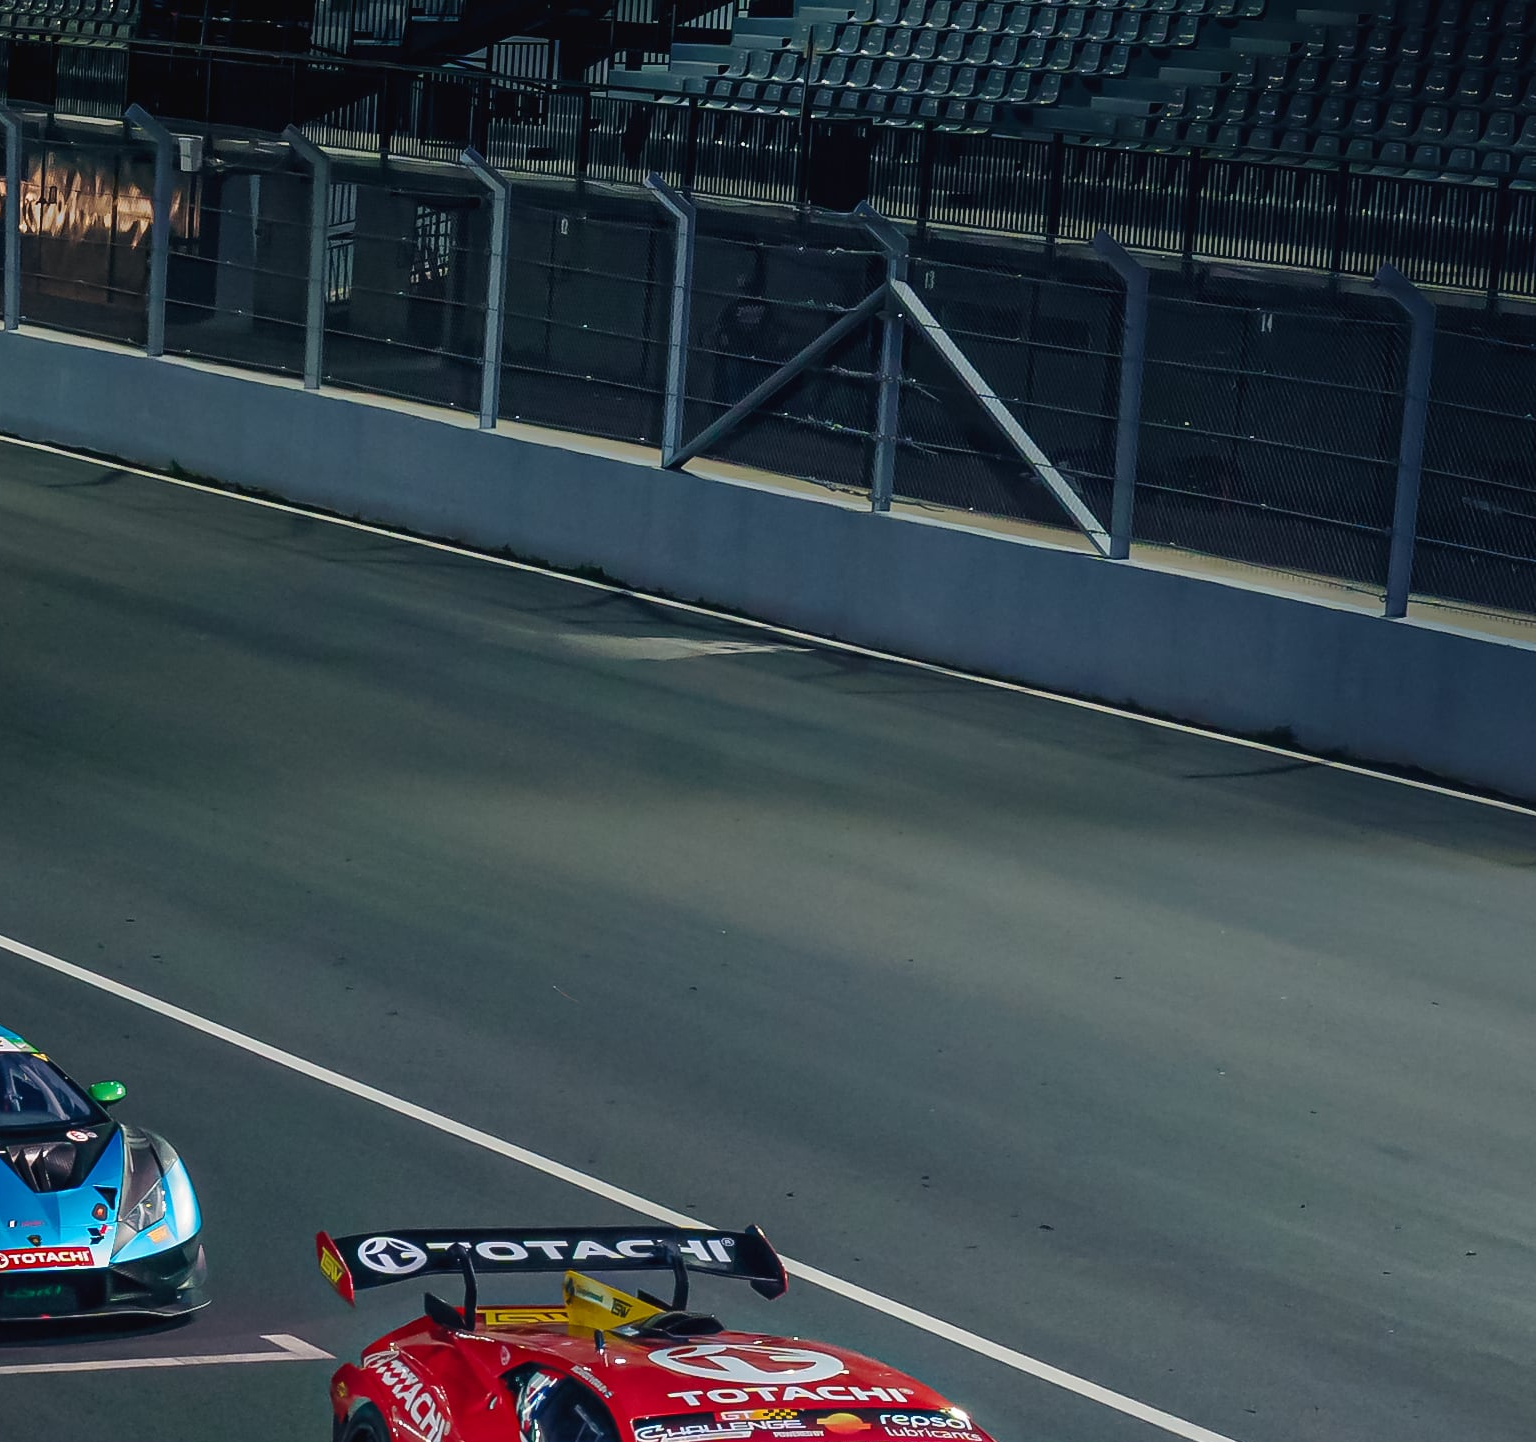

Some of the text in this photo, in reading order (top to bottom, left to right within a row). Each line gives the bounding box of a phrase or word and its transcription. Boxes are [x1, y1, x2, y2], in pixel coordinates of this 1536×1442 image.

[8, 1250, 90, 1265] TOTACHI
[719, 1410, 754, 1421] GT
[879, 1413, 974, 1431] repsol
[884, 1426, 983, 1442] lubricants
